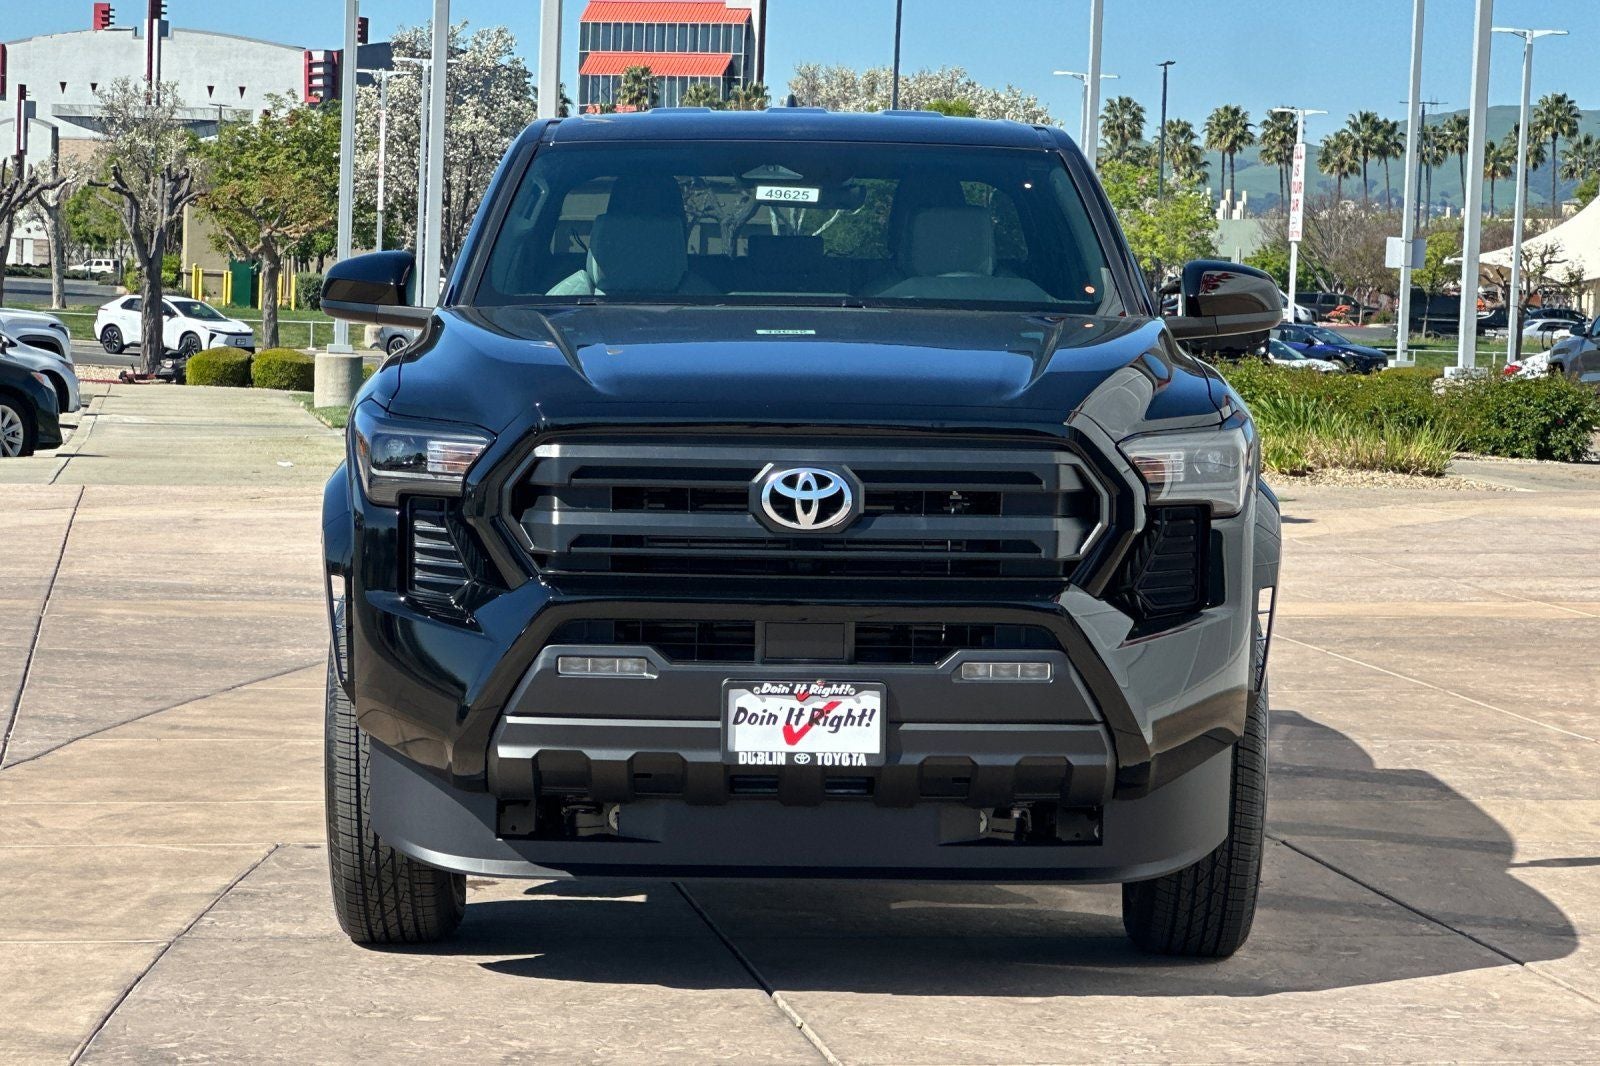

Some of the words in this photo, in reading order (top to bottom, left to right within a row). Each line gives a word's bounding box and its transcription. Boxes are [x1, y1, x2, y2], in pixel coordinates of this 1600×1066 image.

[765, 189, 810, 200] 49625
[760, 683, 793, 695] Doin'
[794, 684, 809, 695] It
[809, 684, 850, 698] Right!
[732, 706, 783, 726] Doin'
[785, 707, 805, 726] It
[808, 708, 876, 734] Right!
[738, 752, 786, 765] DUBLIN
[816, 752, 867, 767] TOYOTA
